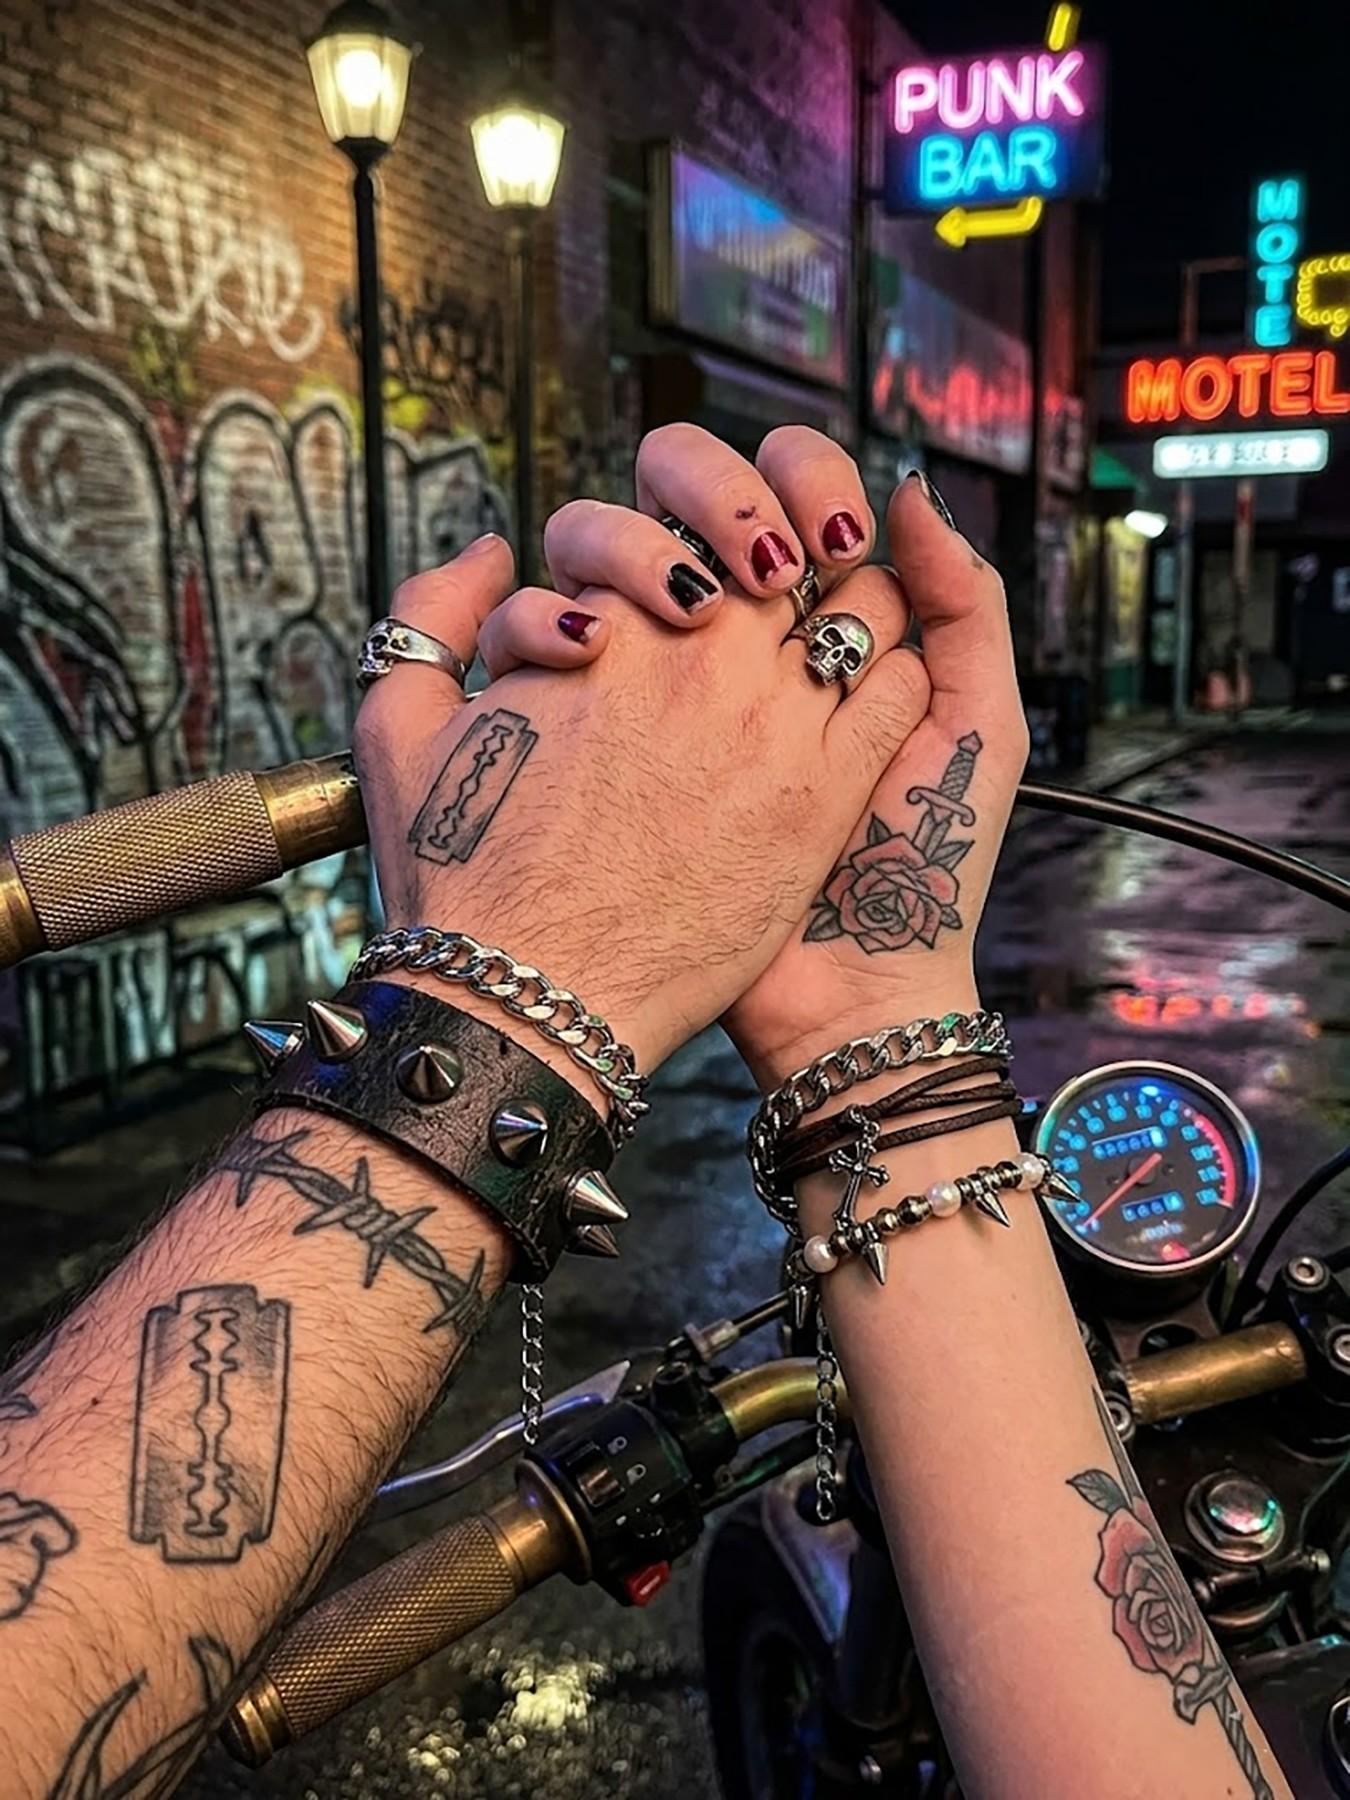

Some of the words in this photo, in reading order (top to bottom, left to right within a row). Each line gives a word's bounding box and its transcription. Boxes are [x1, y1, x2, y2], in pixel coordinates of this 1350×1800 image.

[895, 51, 1084, 134] PUNK
[920, 126, 1057, 199] BAR
[1255, 180, 1299, 347] MOTE
[1128, 351, 1350, 423] MOTEL
